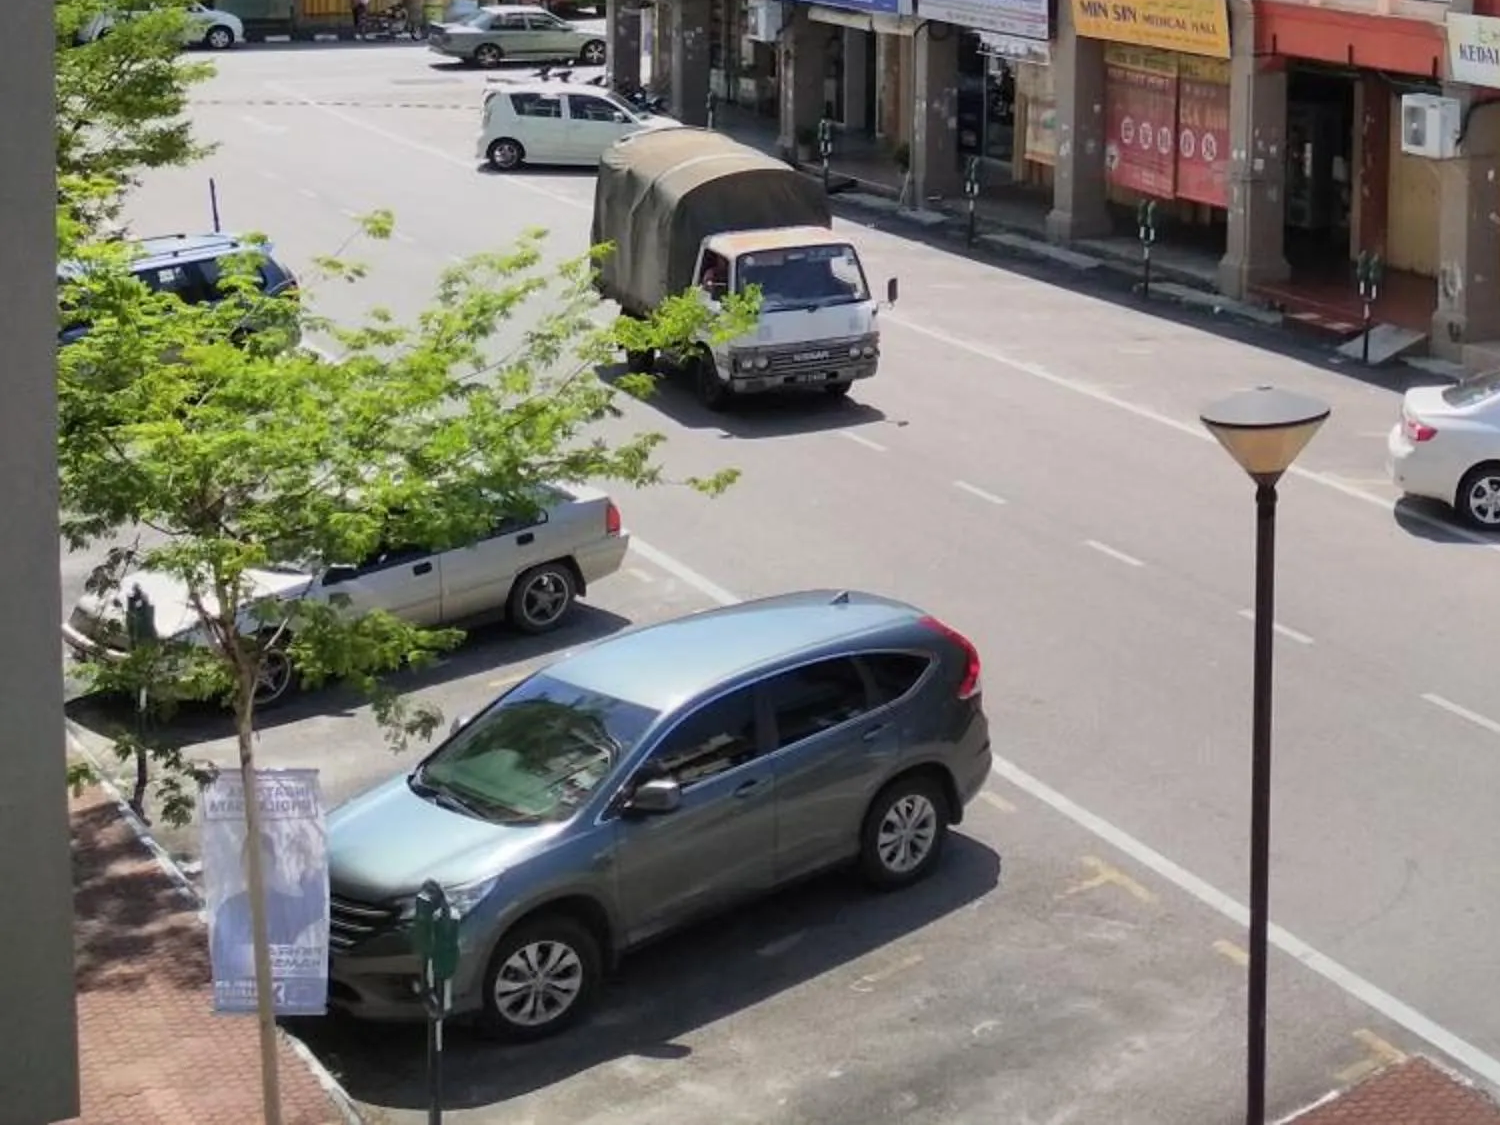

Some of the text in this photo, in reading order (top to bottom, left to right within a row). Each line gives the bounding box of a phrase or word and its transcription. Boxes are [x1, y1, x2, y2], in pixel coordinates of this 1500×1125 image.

[1080, 0, 1109, 19] MIN
[1112, 3, 1137, 23] SIN
[1142, 14, 1186, 31] MEDICAL
[1191, 21, 1217, 35] HALL
[1459, 43, 1499, 65] KEDAI
